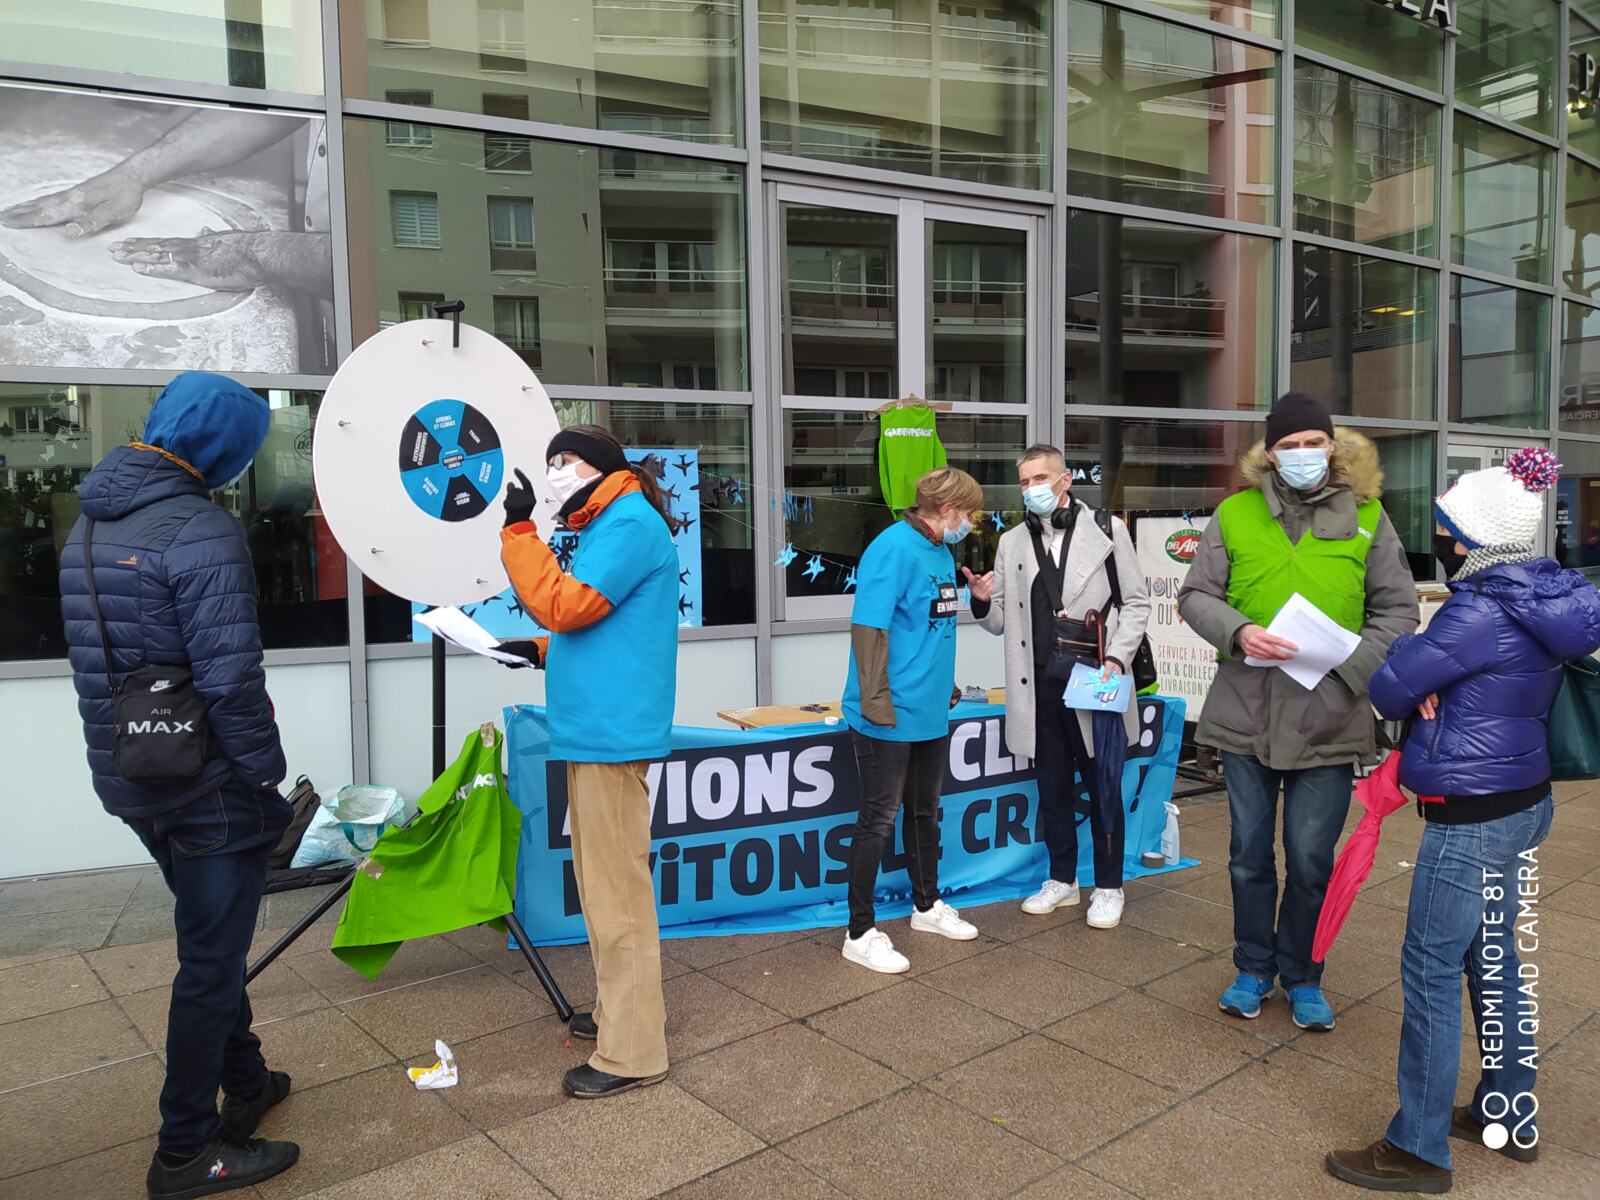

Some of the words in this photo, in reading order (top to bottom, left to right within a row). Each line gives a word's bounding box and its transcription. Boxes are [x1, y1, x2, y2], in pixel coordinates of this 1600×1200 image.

[1157, 644, 1188, 661] SERVICE
[1154, 660, 1171, 675] LICK
[1183, 663, 1217, 681] COLLECT
[1160, 678, 1203, 697] LIVRAISON
[150, 707, 173, 717] AIR
[127, 720, 195, 735] MAX
[562, 745, 835, 836] VIONS
